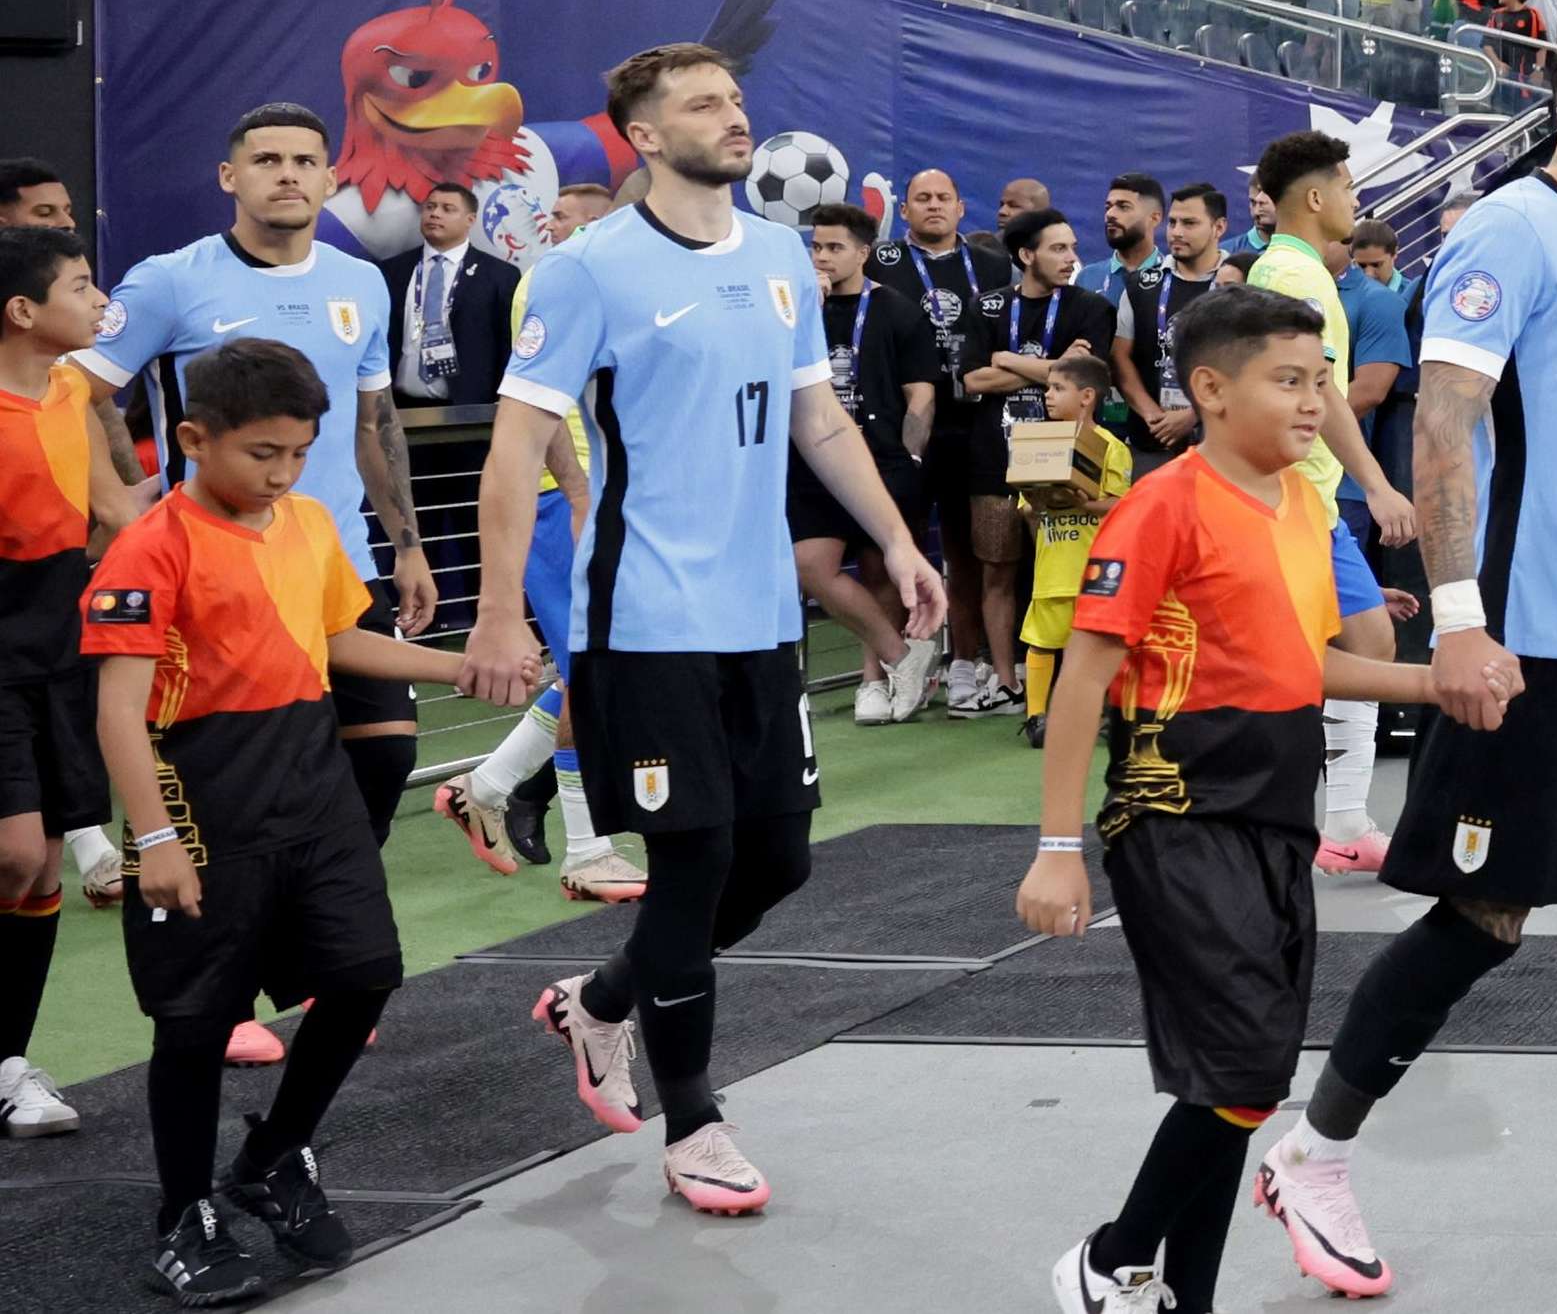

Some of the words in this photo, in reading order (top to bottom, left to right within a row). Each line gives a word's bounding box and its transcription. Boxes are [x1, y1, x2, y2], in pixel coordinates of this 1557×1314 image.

[735, 380, 769, 448] 17
[1048, 528, 1079, 542] livre
[198, 1199, 218, 1241] adidas
